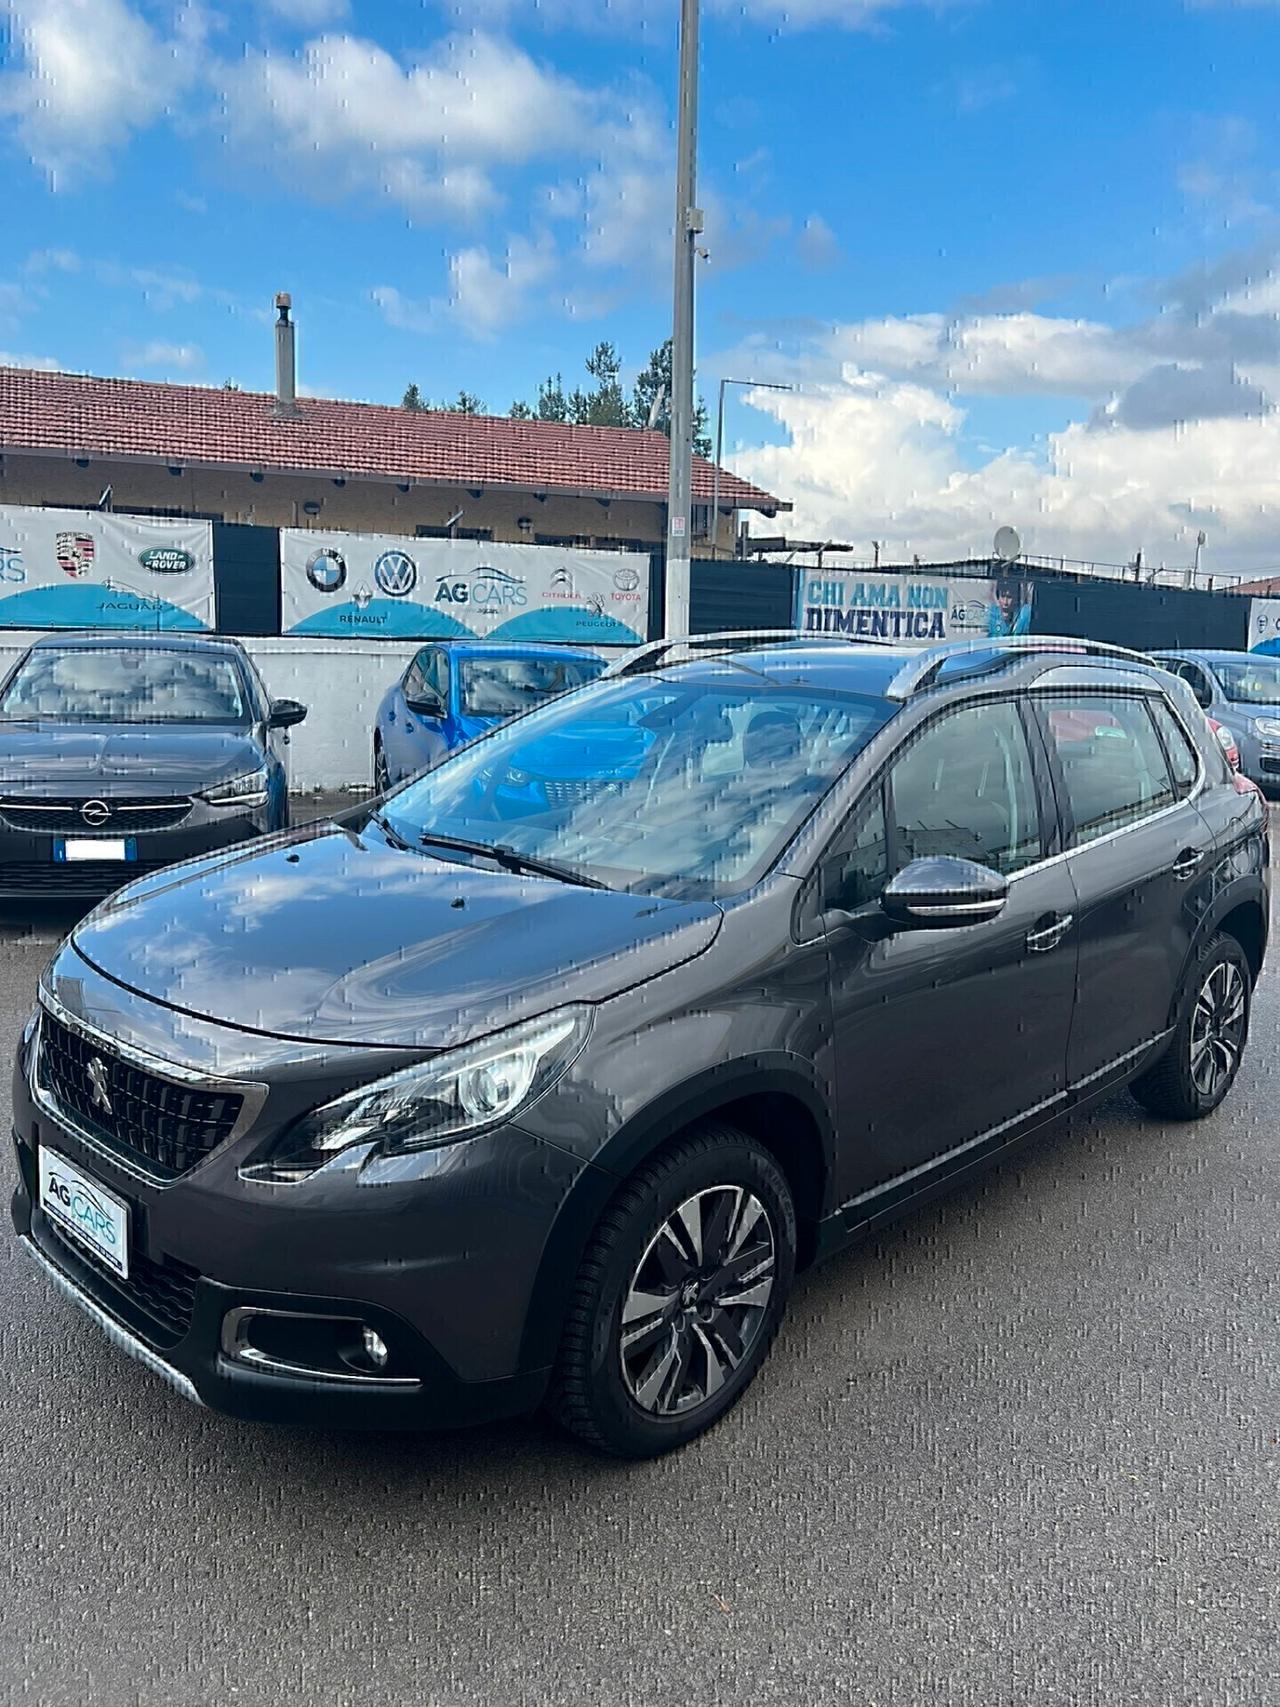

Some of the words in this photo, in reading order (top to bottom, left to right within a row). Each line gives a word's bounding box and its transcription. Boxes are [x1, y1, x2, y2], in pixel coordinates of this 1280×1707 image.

[148, 550, 178, 560] LAND
[151, 559, 187, 570] ROVER
[610, 592, 641, 601] TOYOTA
[807, 580, 845, 606] CHI
[850, 582, 901, 608] AMA
[907, 584, 949, 609] NON
[96, 601, 164, 610] JAGUAR
[339, 614, 388, 625] RENAULT
[804, 607, 947, 639] DIMENTICA
